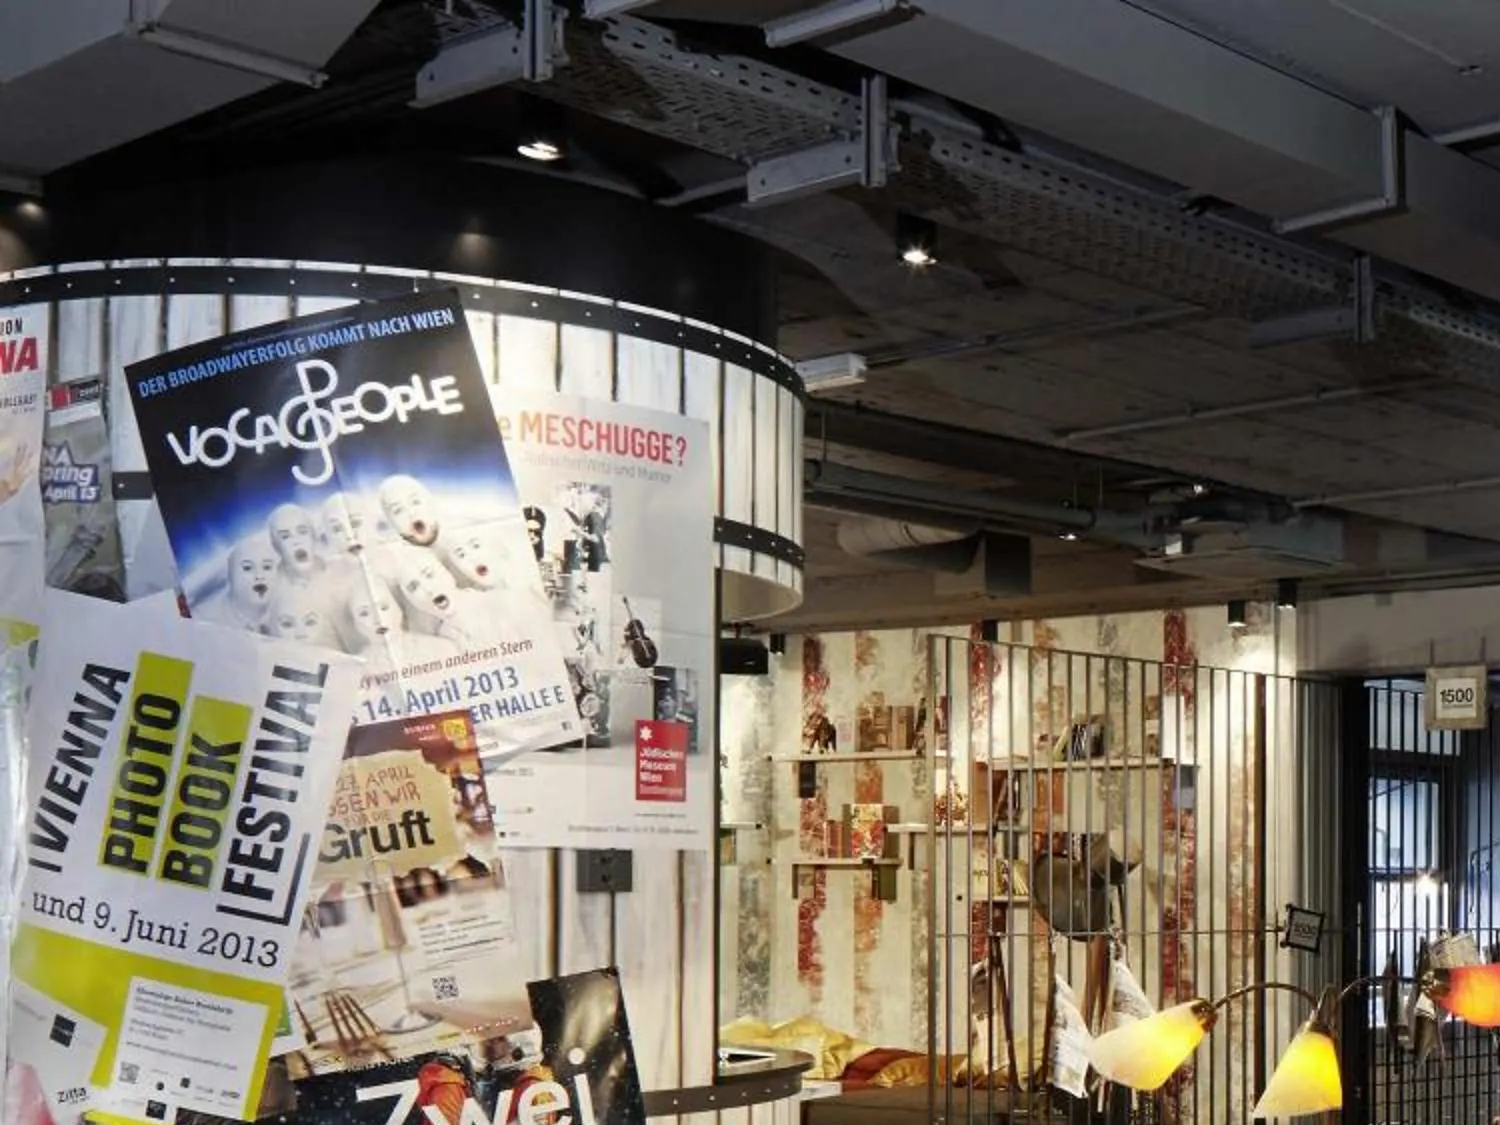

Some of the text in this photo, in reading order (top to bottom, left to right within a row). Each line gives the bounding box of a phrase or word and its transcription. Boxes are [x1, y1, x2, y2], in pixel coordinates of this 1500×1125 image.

[138, 307, 455, 398] DER BROADWAYERFOLG KOMMT NACH WIEN
[519, 409, 687, 468] MESCHUGGE?
[375, 668, 400, 685] von
[401, 658, 443, 679] einem
[446, 646, 498, 668] anderen
[500, 638, 534, 655] Stern
[406, 677, 461, 713] April
[465, 666, 519, 698] 2013
[497, 687, 552, 716] HALLE
[553, 685, 566, 703] E
[28, 663, 131, 853] VIENNA
[103, 692, 182, 873] PHOTO
[220, 662, 330, 902] FESTIVAL
[162, 732, 243, 889] BOOK
[318, 809, 435, 863] Gruft
[32, 890, 280, 968] und 9. Juni 2013
